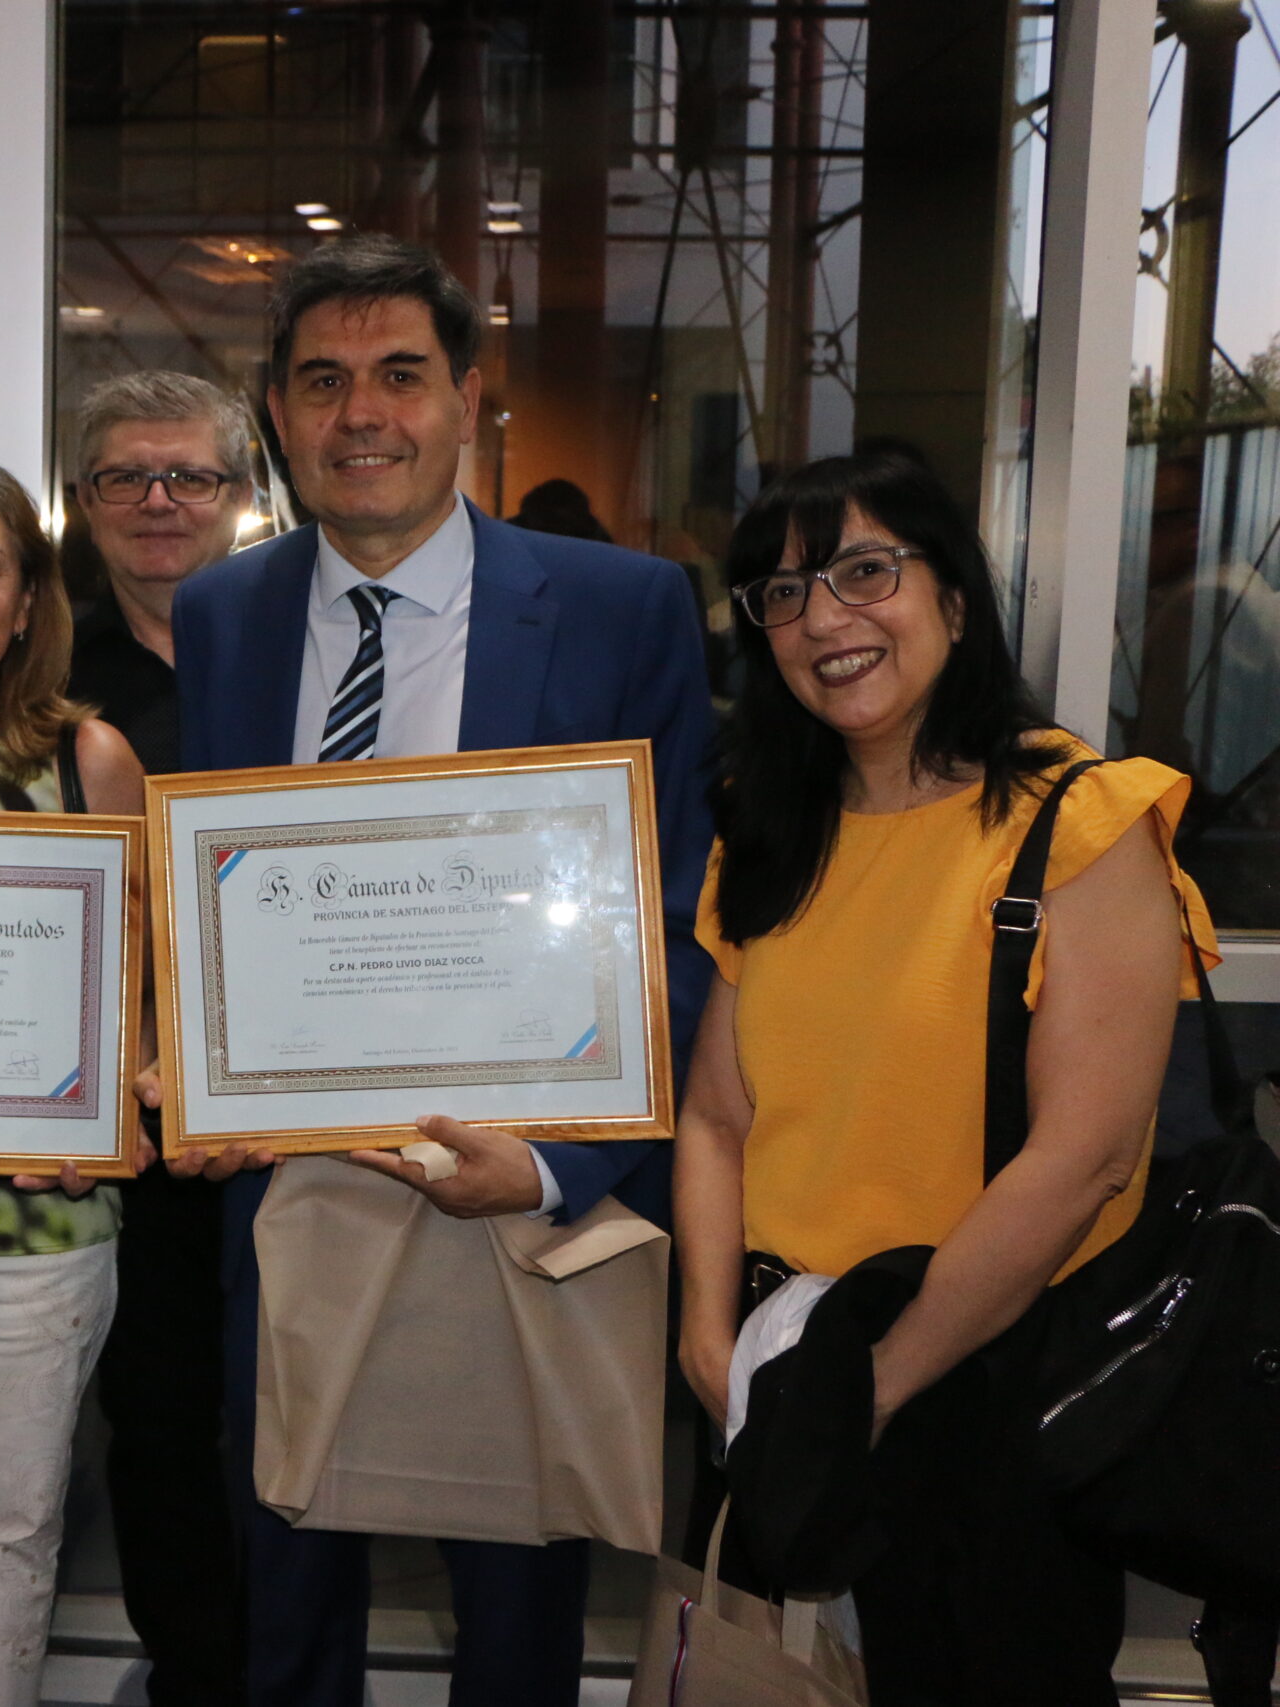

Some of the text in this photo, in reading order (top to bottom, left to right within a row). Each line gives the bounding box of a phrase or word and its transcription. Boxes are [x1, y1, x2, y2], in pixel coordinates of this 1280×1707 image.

[308, 862, 410, 910] Cámara
[417, 872, 436, 894] de
[441, 850, 558, 903] Diputad
[314, 910, 370, 921] PROVINCIA
[373, 908, 386, 918] DE
[390, 906, 444, 918] SANTIAGO
[448, 904, 469, 914] DEL
[330, 956, 484, 972] C.P.N. PEDRO LIVIO DIAZ YOCCA
